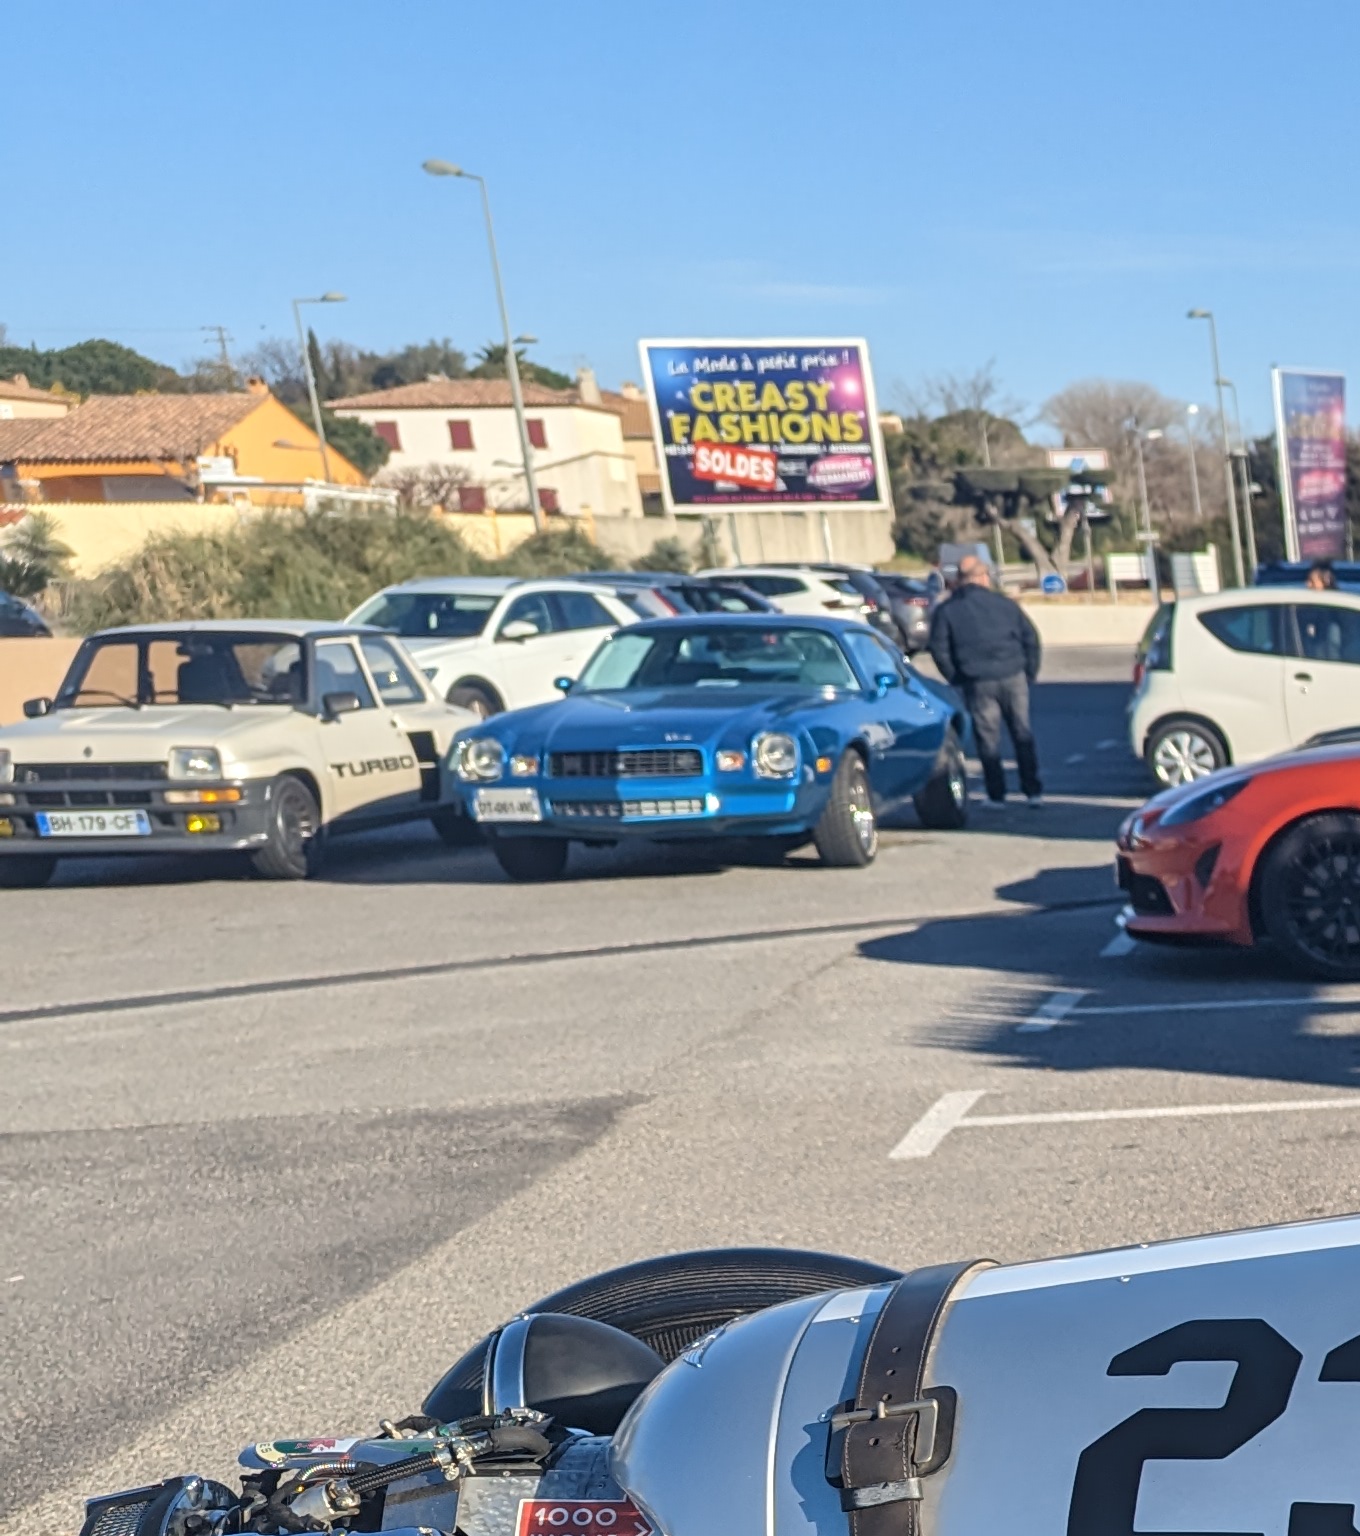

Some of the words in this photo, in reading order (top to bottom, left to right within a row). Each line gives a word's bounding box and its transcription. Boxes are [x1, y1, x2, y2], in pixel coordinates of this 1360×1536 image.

[667, 360, 689, 376] La
[693, 355, 738, 373] Mode
[756, 351, 798, 374] petit
[801, 350, 839, 372] prix
[690, 380, 832, 412] CREASY
[670, 411, 864, 443] FASHIONS
[695, 448, 777, 483] SOLDES
[331, 756, 415, 779] TURBO
[535, 1507, 617, 1526] 1000
